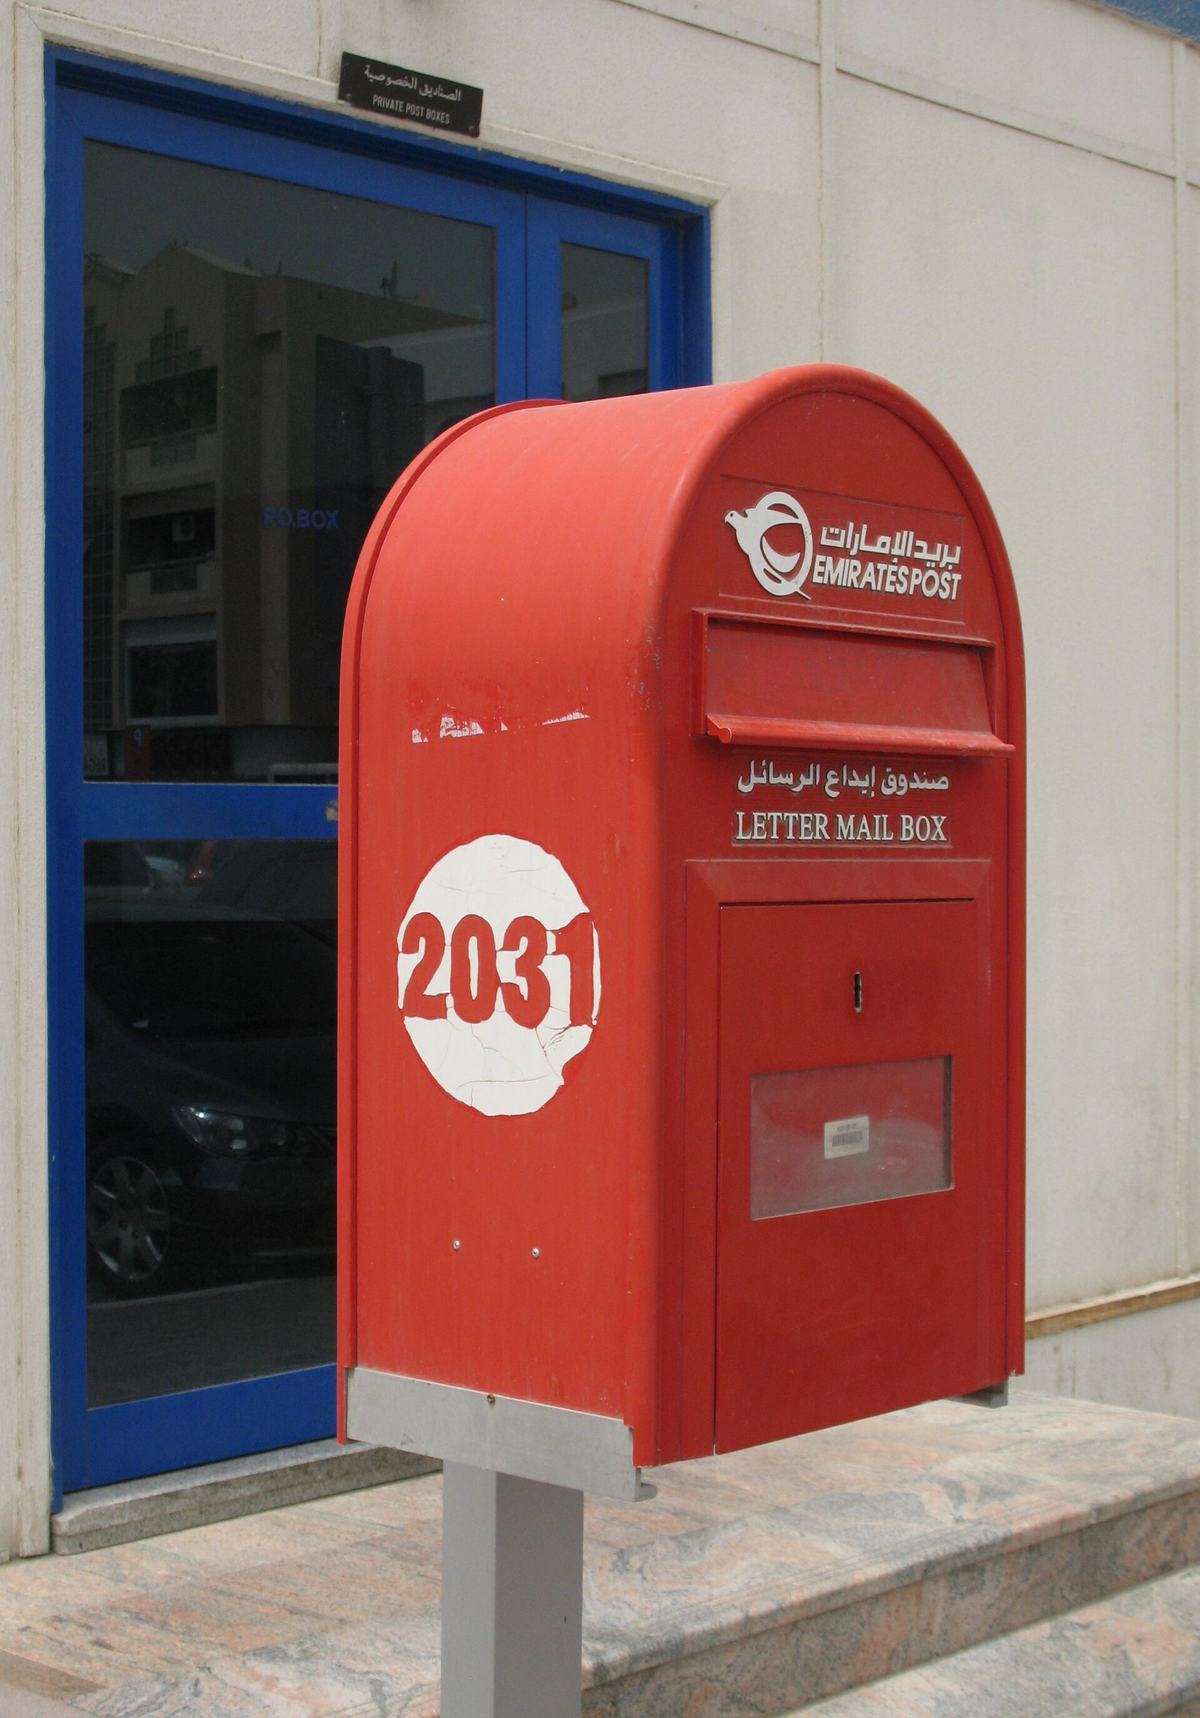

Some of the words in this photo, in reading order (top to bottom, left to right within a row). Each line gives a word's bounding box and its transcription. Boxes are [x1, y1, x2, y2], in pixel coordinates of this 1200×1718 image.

[363, 64, 418, 90] الخصوصية
[418, 83, 462, 102] الصناديق
[372, 94, 404, 113] PRIVATE
[405, 102, 425, 118] POST
[425, 107, 451, 125] BOXES
[737, 759, 820, 793] الرسائل
[824, 764, 876, 798] إيداع
[880, 767, 949, 796] صندوق
[735, 811, 830, 840] LETTER
[836, 814, 894, 841] MAIL
[900, 814, 947, 841] BOX
[398, 911, 594, 1029] 2031
